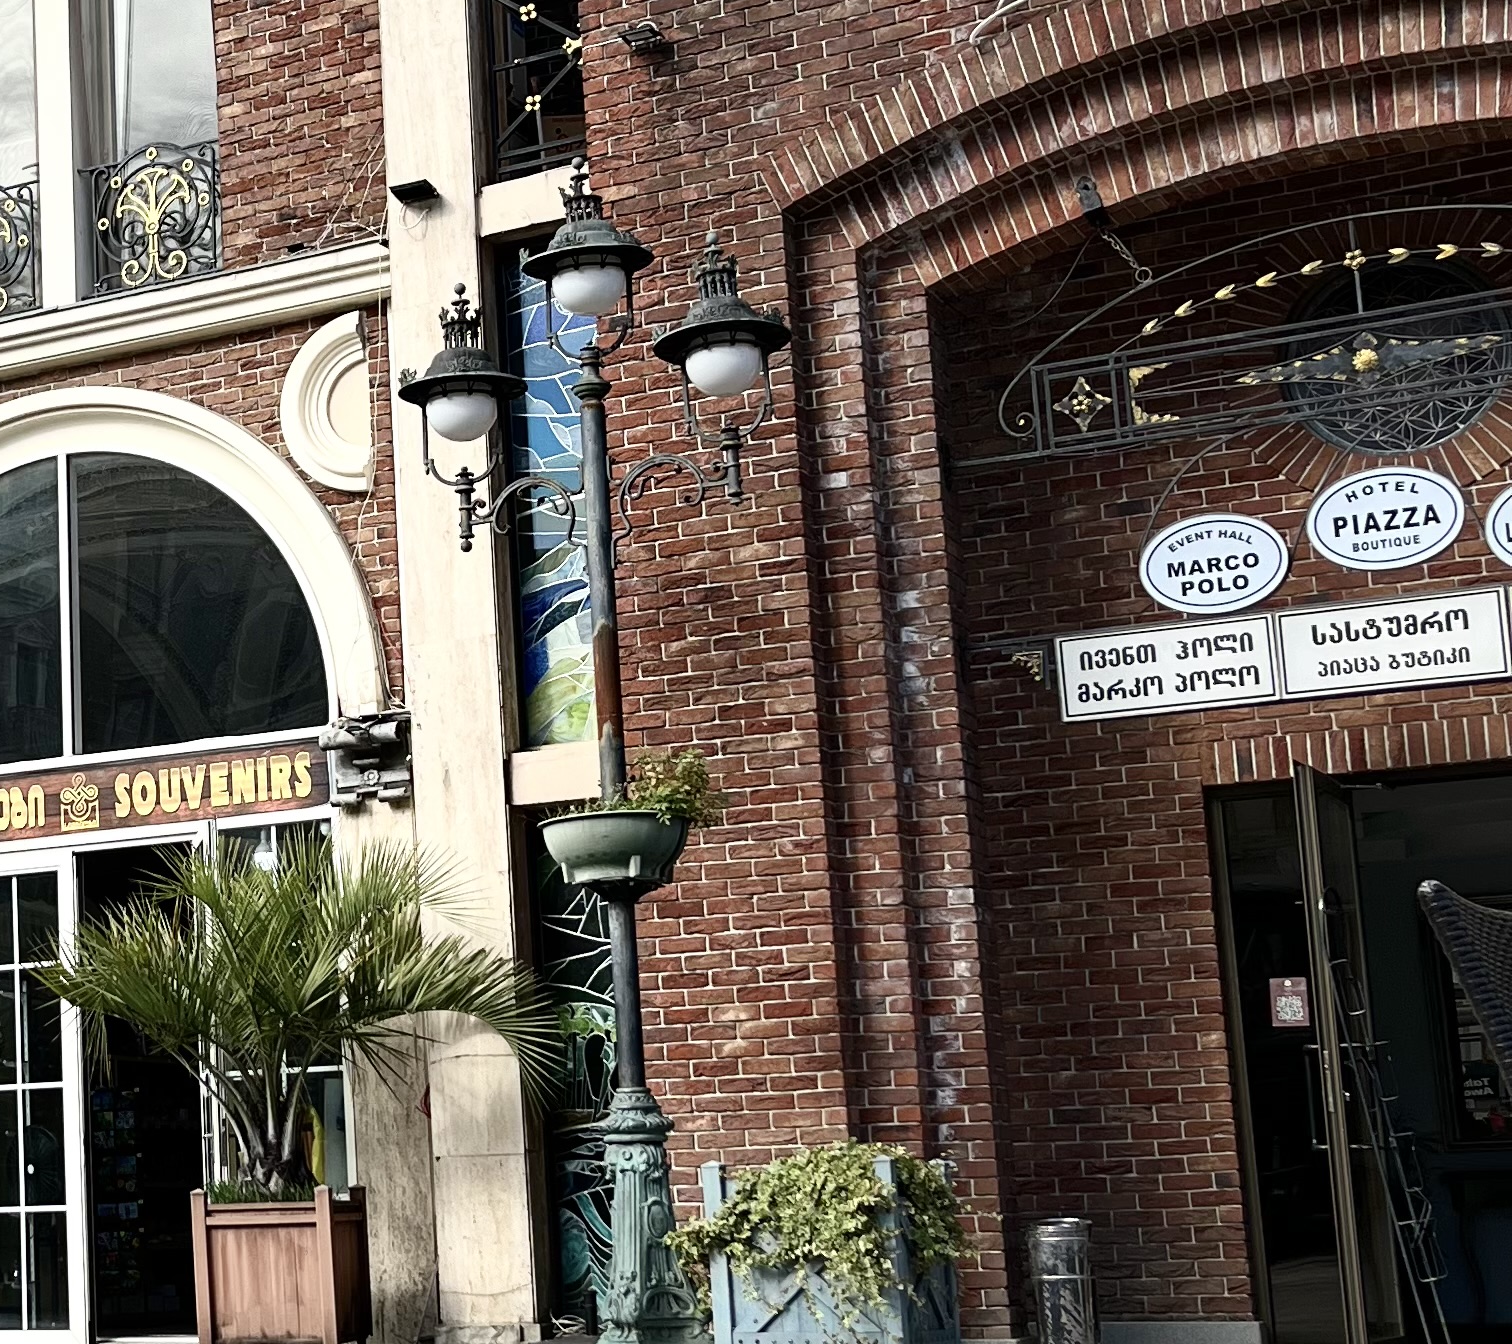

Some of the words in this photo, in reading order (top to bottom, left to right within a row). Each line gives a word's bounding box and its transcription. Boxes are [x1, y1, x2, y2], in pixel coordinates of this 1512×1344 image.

[1345, 481, 1419, 503] HOTEL
[1332, 504, 1441, 538] PIAZZA
[1168, 529, 1213, 553] EVENT
[1218, 529, 1253, 545] HALL
[1352, 534, 1421, 553] BOUTIQUE
[1166, 552, 1260, 578] MARCO
[1180, 574, 1249, 597] POLO
[1310, 608, 1470, 646] სასტუმრო
[1079, 643, 1157, 671] ივენთ
[1175, 631, 1254, 660] ჰოლი
[1317, 655, 1381, 677] პიაცა
[1388, 646, 1471, 670] ბუტიკი
[1077, 674, 1164, 703] მარკო
[1175, 664, 1260, 693] პოლო
[114, 750, 313, 819] SOUVENIRS
